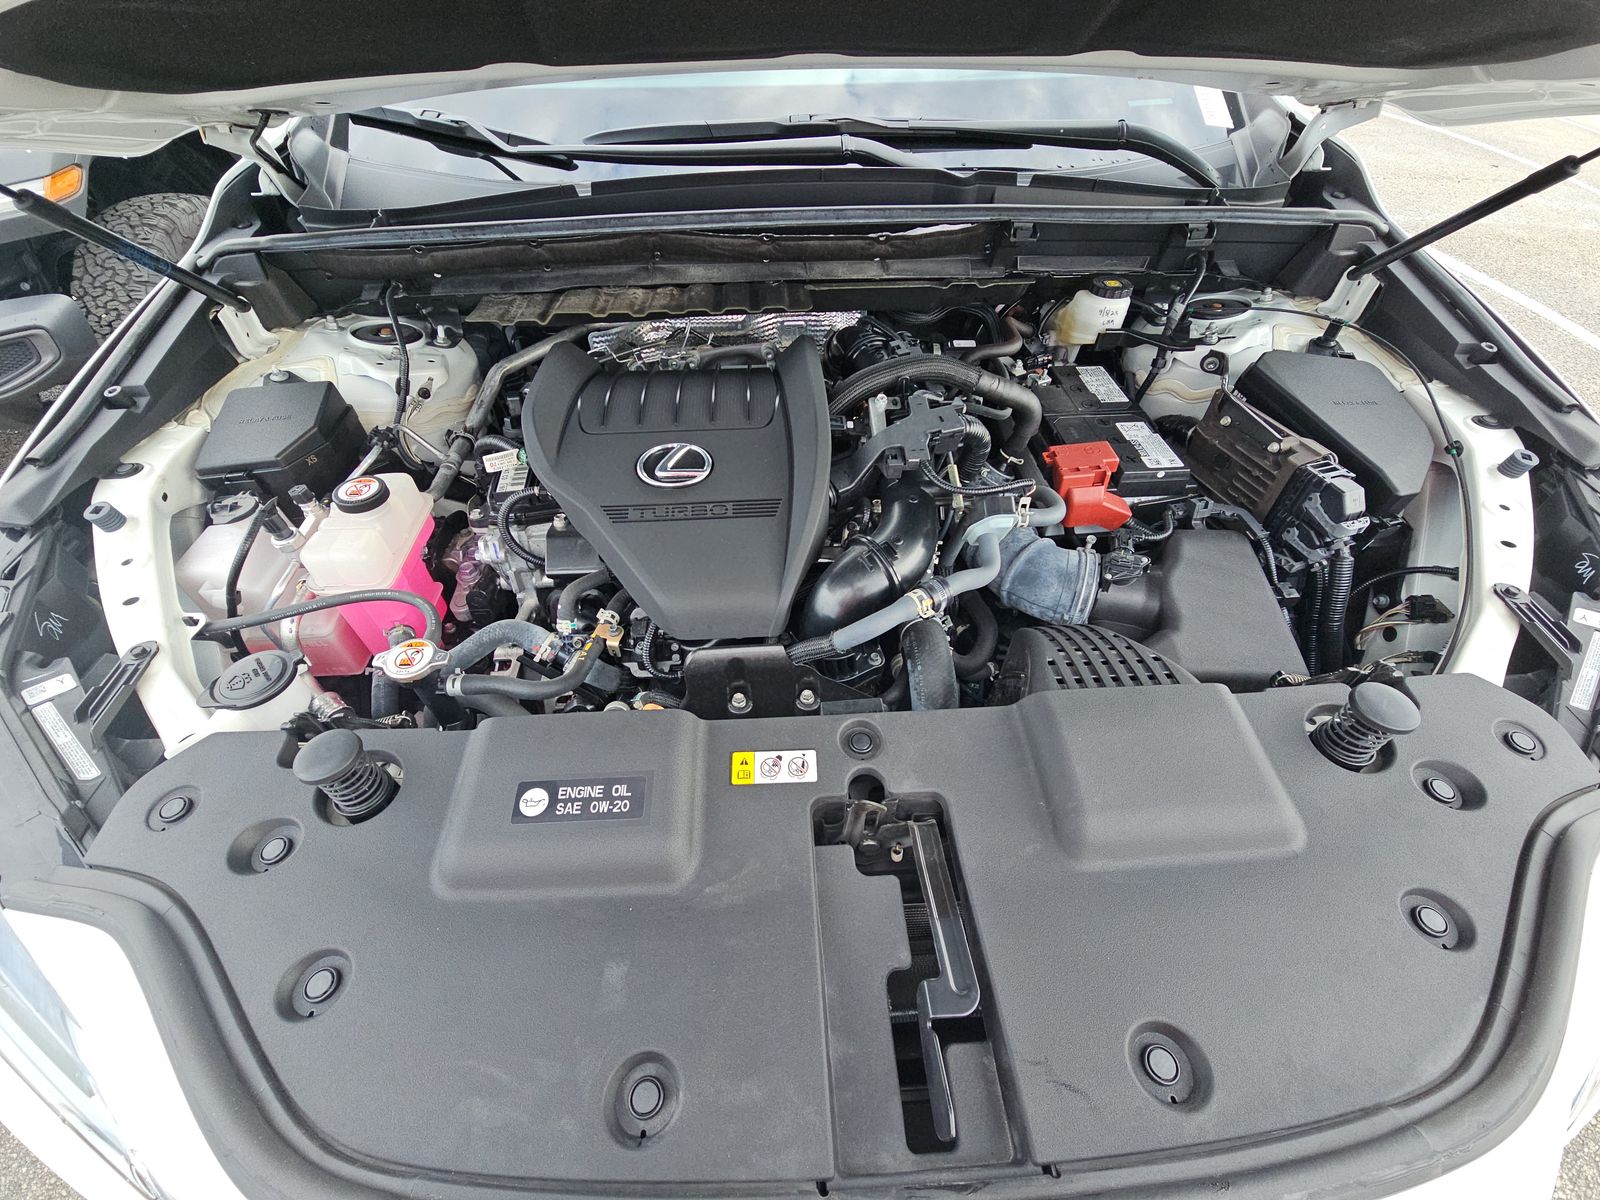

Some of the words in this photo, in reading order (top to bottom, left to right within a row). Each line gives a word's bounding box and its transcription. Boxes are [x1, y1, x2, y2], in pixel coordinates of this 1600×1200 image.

[633, 504, 728, 518] TURBO
[558, 785, 605, 799] ENGINE
[612, 784, 632, 797] OIL
[555, 801, 583, 815] SAE
[590, 799, 630, 813] 0W-20
